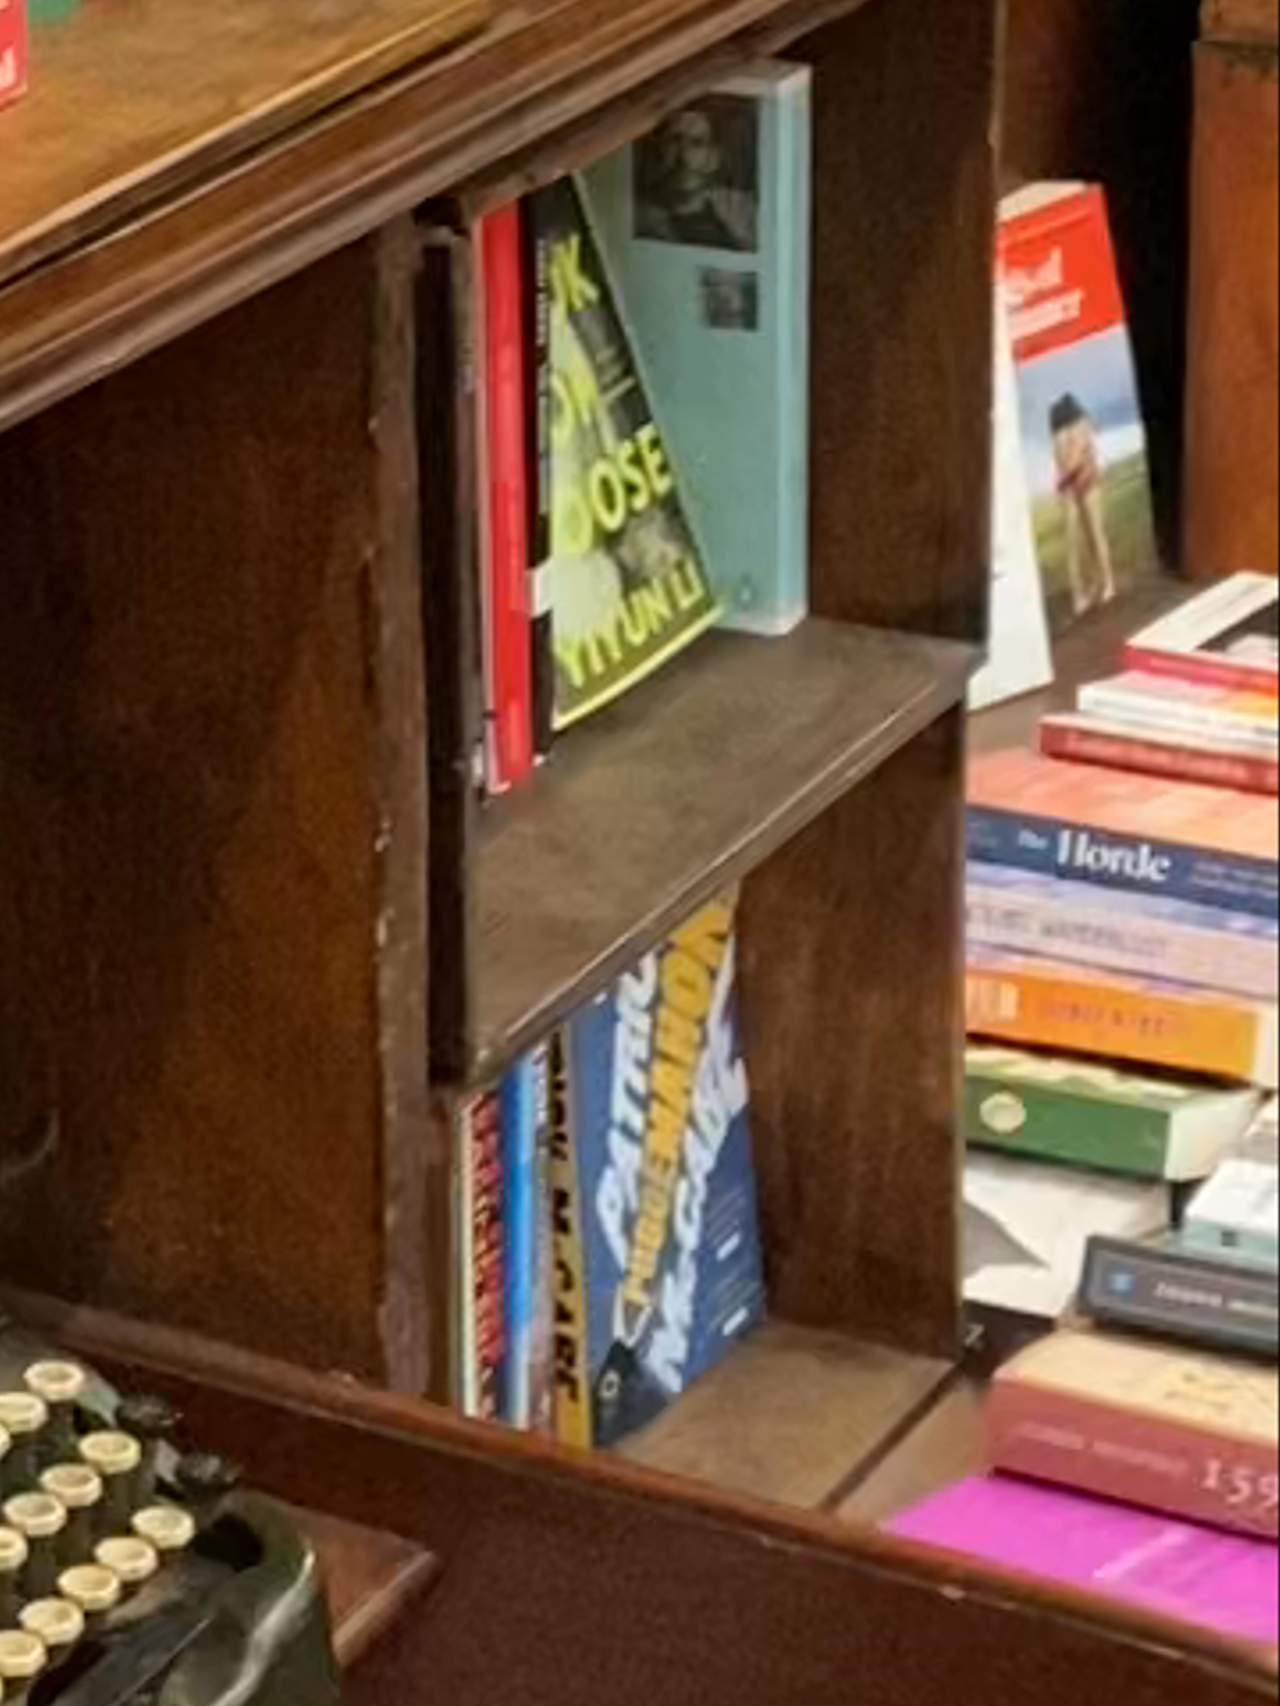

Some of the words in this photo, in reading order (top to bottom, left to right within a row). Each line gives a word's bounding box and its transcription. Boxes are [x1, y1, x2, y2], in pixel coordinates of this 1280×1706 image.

[555, 421, 673, 554] OOSE
[553, 579, 674, 687] YIYUN
[668, 556, 706, 610] LI
[1056, 828, 1172, 884] Horde
